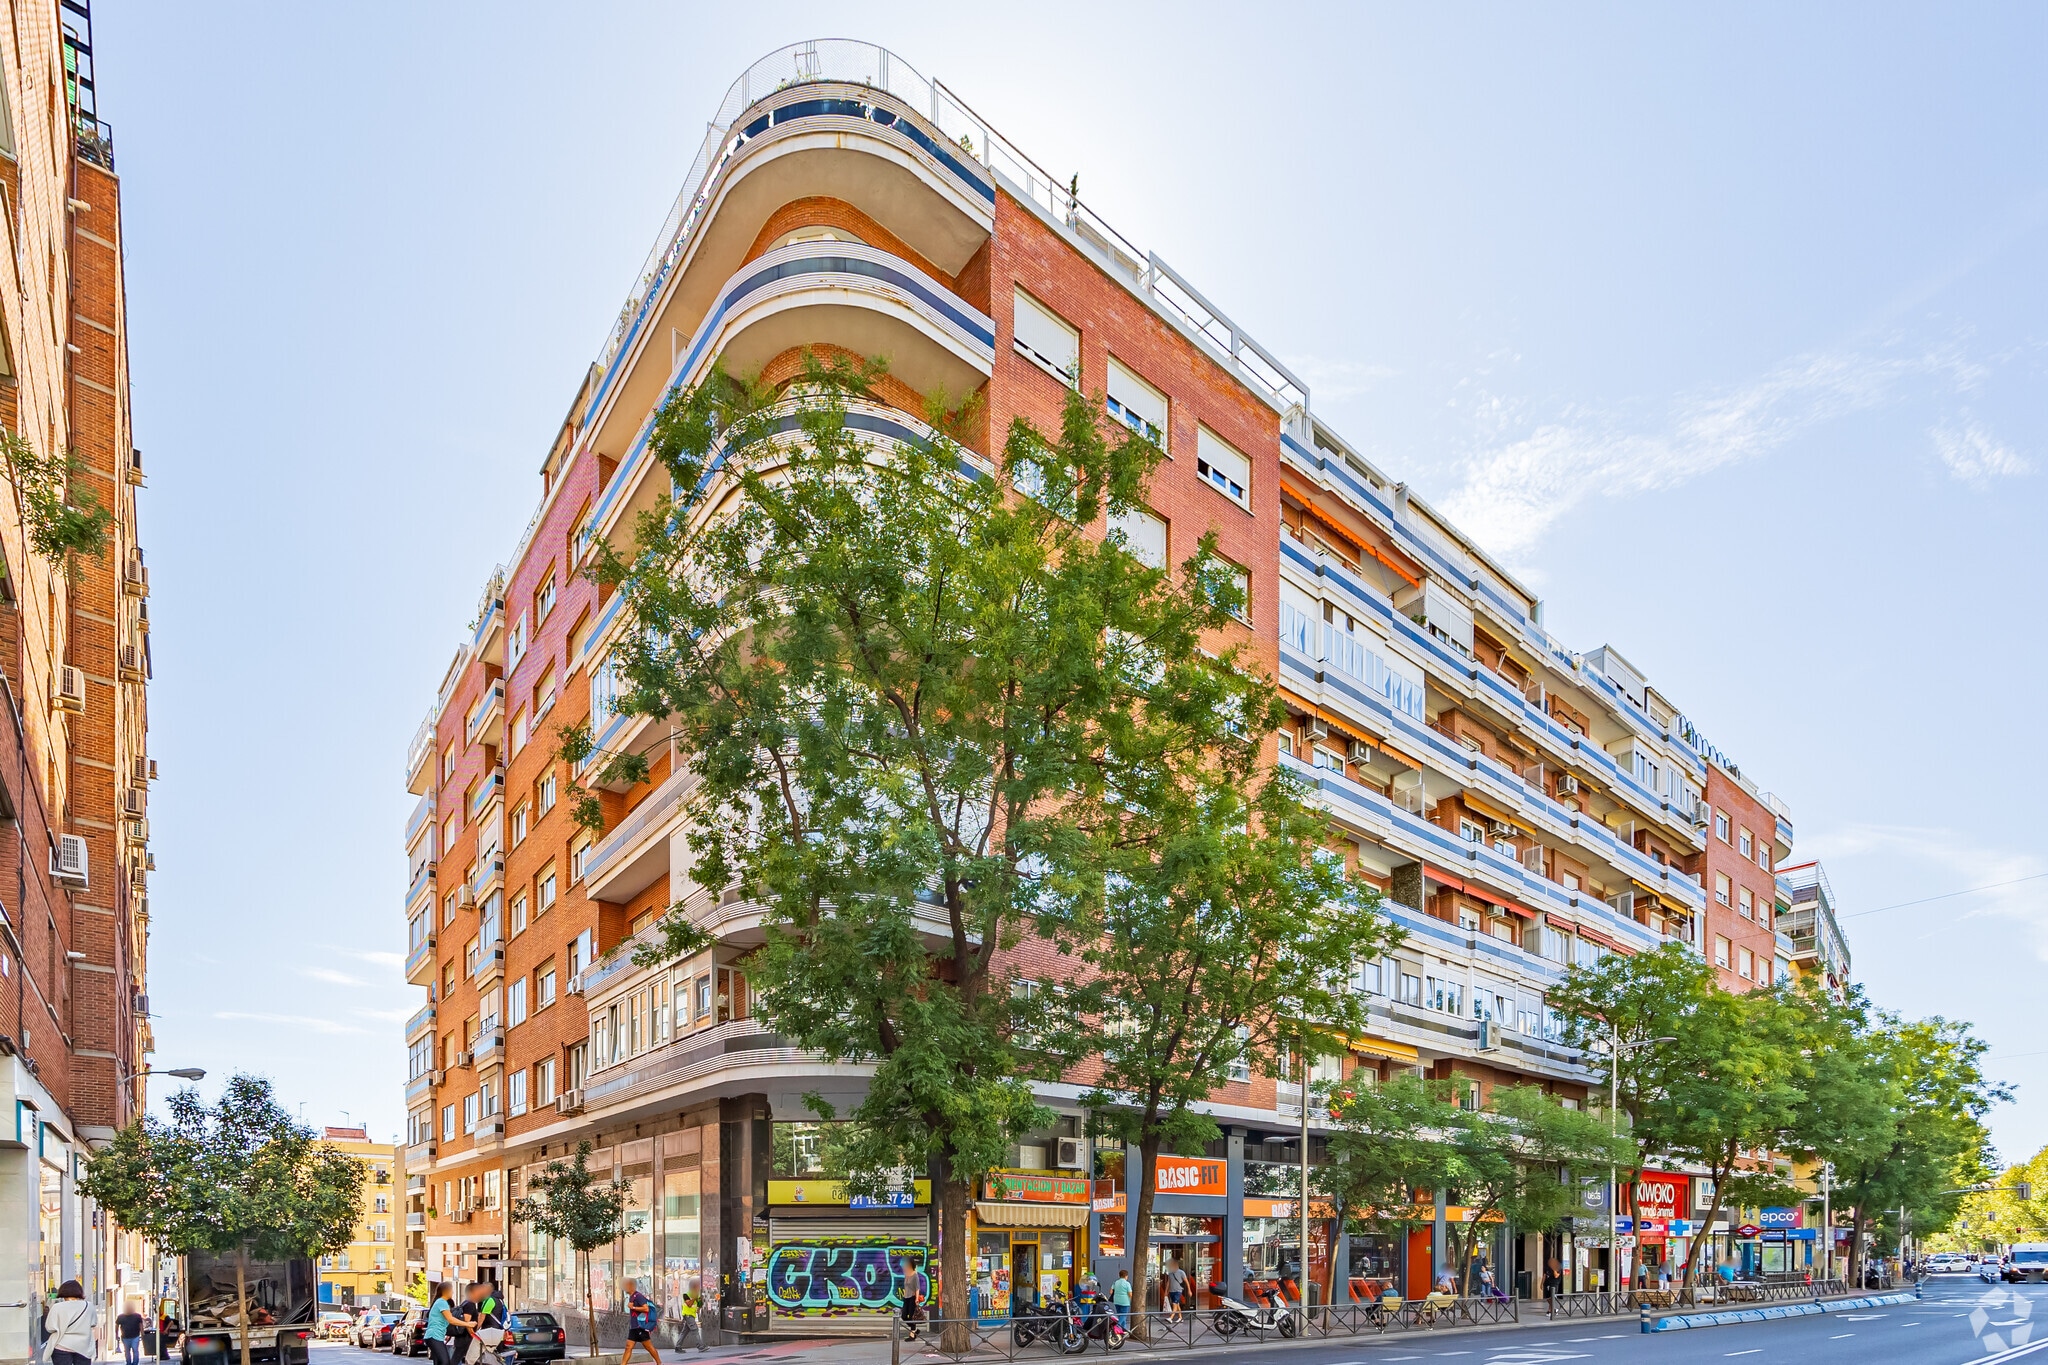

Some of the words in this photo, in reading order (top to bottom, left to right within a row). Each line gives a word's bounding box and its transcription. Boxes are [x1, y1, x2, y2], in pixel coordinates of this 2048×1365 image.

[1054, 1181, 1059, 1193] Y
[1061, 1181, 1086, 1195] BAZAR
[1637, 1182, 1675, 1204] KIWOKO
[1701, 1182, 1717, 1195] MA
[900, 1193, 913, 1204] 29
[1657, 1205, 1675, 1218] animal
[1760, 1212, 1795, 1223] epco
